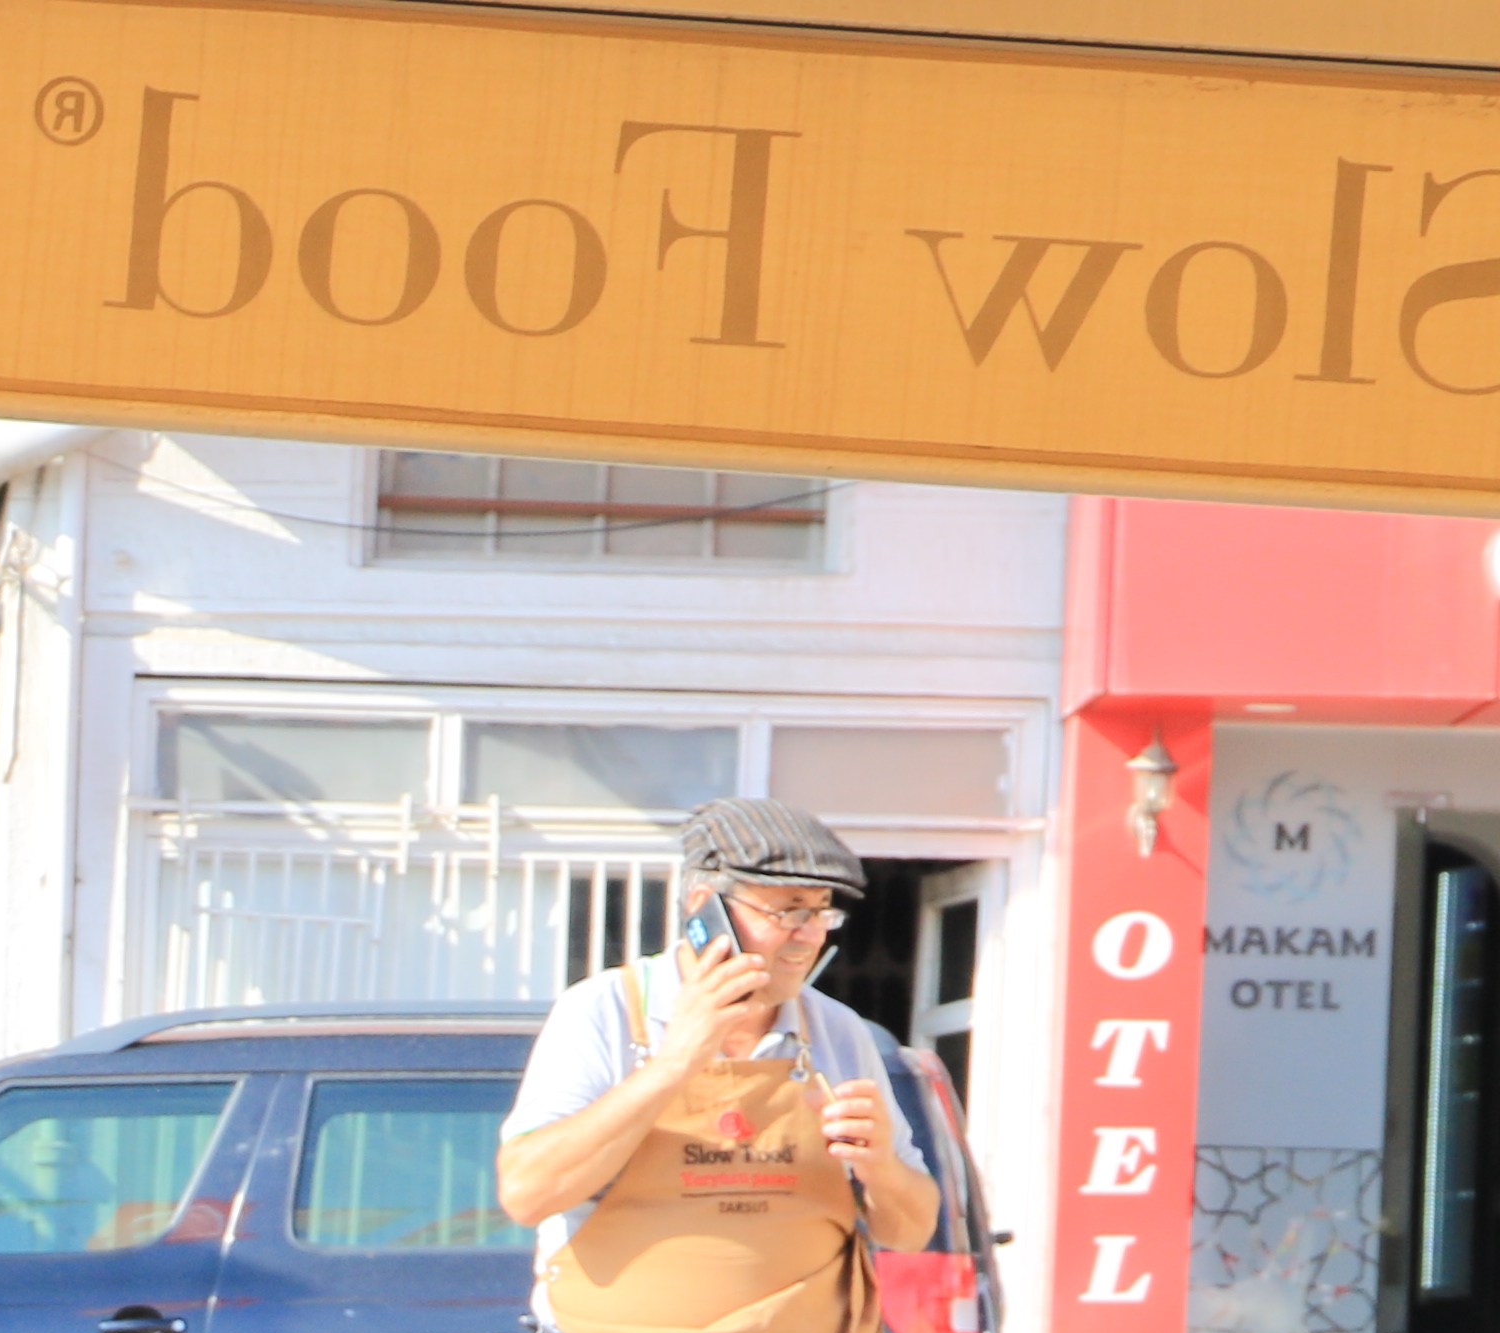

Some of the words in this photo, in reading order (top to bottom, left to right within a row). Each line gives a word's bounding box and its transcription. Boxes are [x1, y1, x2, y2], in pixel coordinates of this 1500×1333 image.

[1274, 822, 1311, 851] M
[1203, 925, 1377, 957] MAKAM
[1231, 980, 1340, 1010] OTEL
[1080, 910, 1174, 1304] OTEL
